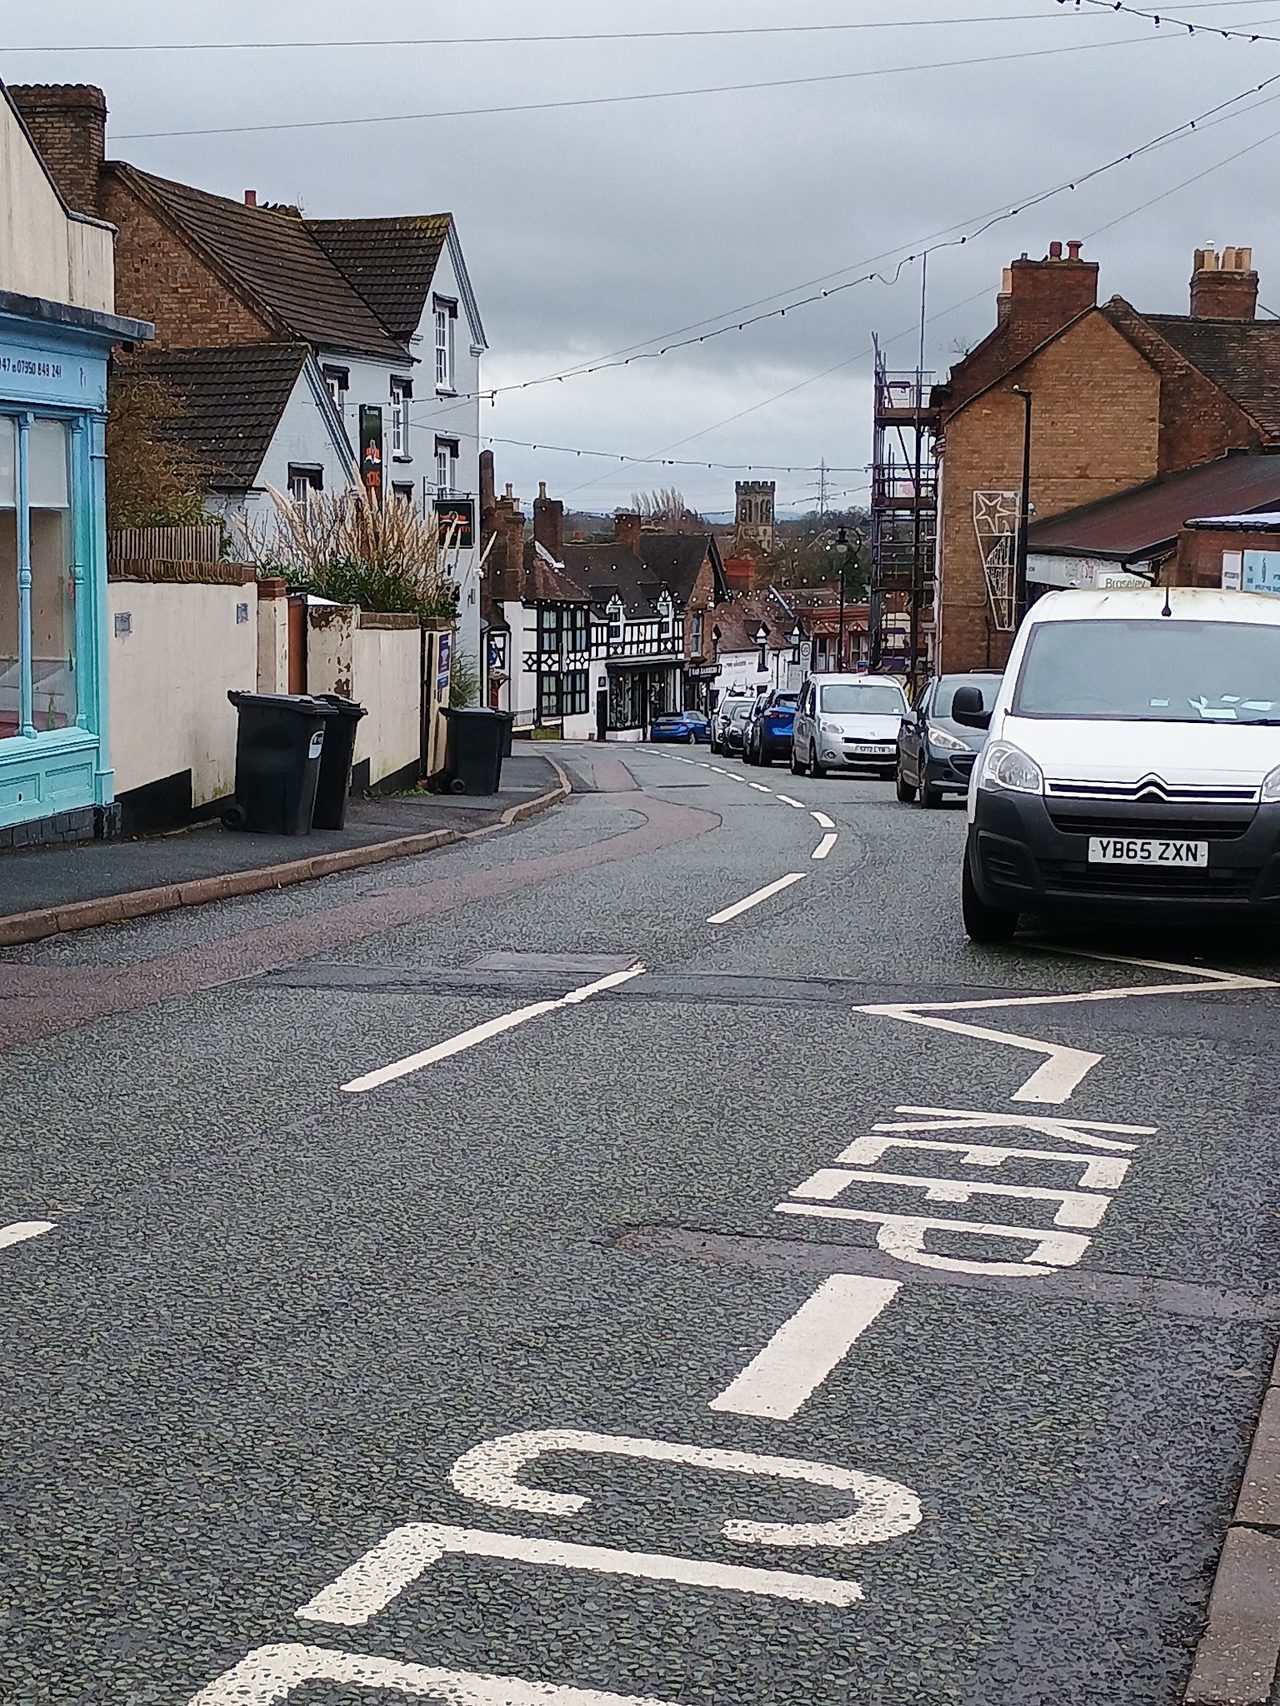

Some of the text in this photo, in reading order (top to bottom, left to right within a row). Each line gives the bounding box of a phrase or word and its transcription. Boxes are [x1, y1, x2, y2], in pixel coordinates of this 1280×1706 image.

[1105, 578, 1146, 589] Broseley
[1099, 840, 1198, 862] YB65 ZXN
[774, 1105, 1160, 1277] KEEP
